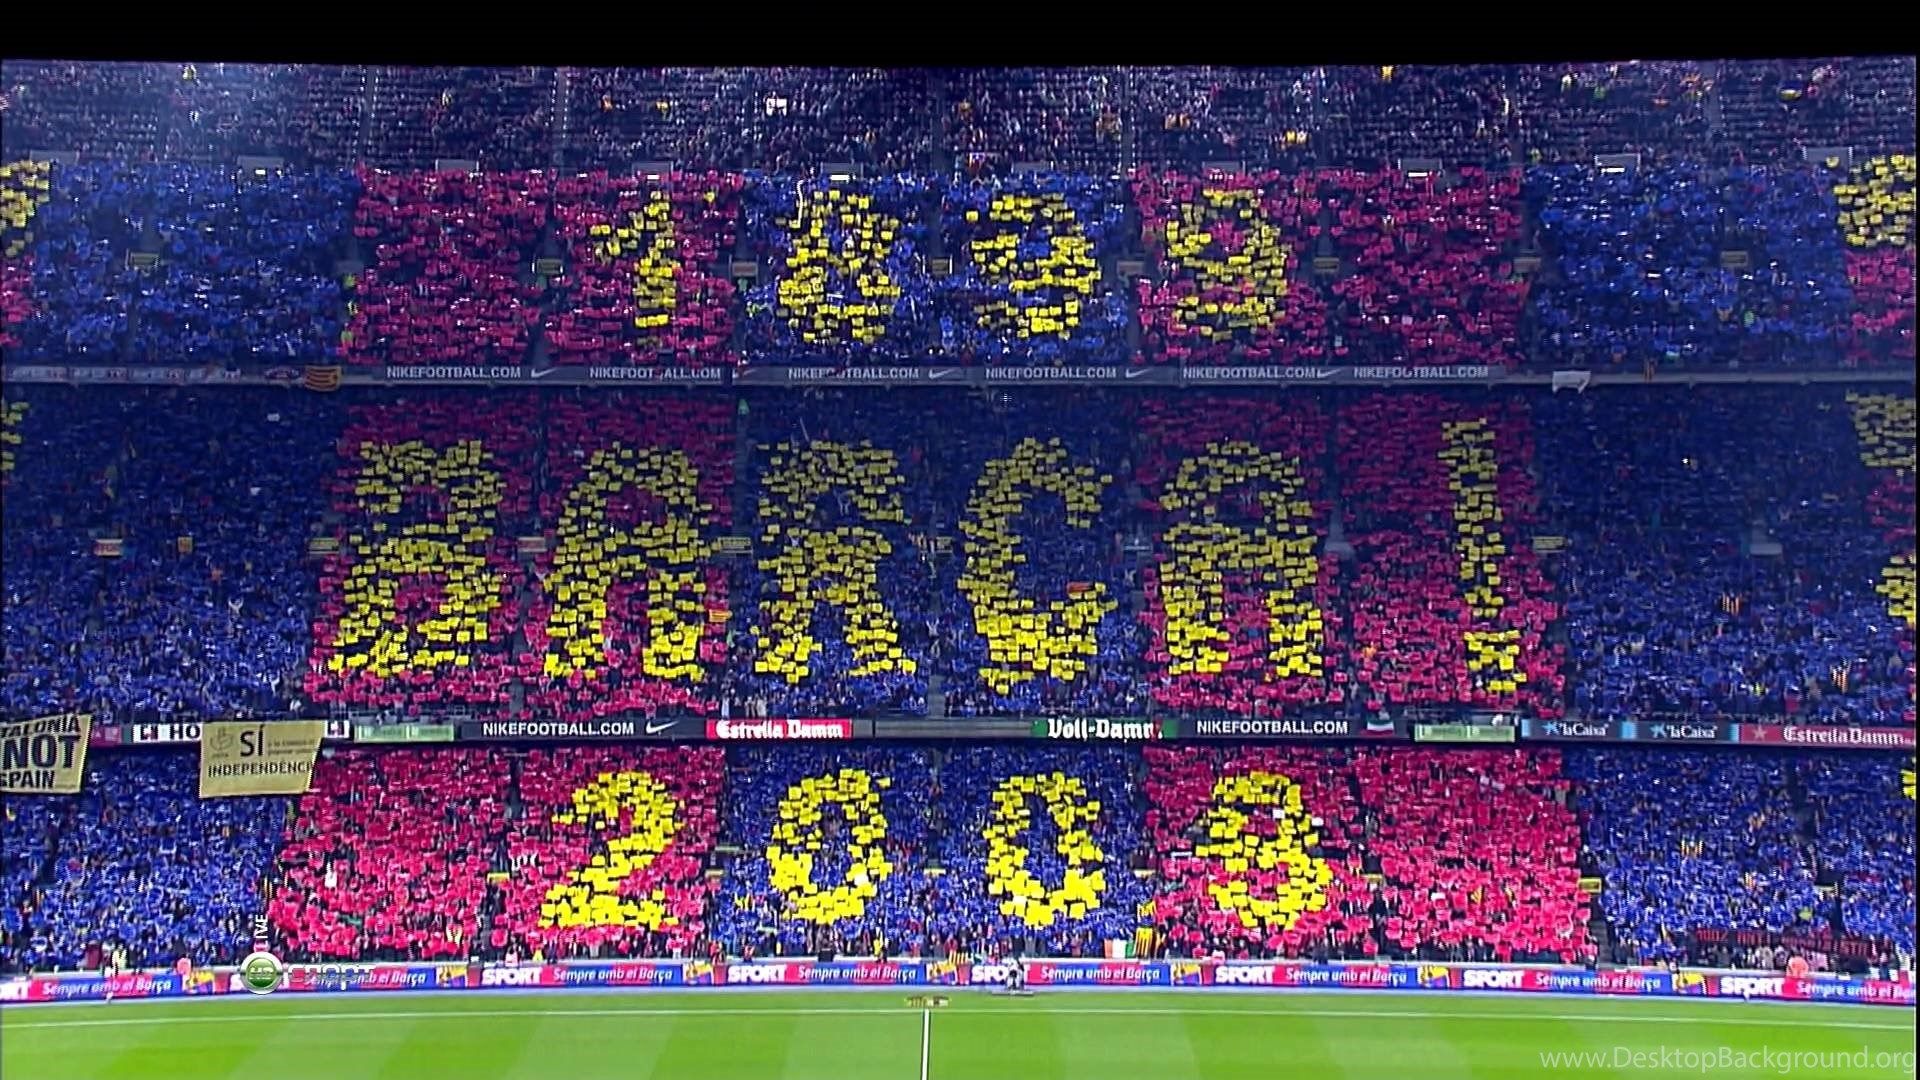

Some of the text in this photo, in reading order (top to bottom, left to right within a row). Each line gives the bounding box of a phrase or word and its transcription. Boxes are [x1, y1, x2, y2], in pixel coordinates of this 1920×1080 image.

[385, 367, 521, 378] NIKEFOOTBALL.COM
[589, 367, 721, 379] NIKEFOOTALL.COM
[985, 368, 1117, 379] NIKEFOOTBALL.COM
[1182, 367, 1316, 379] NIKEFOOTBALL.COM
[483, 722, 634, 736] NIKEFOOTBALL.COM
[716, 719, 844, 739] Estrella Damm
[1197, 721, 1348, 735] NIKEFOOTBALL.COM
[240, 724, 264, 757] SÍ
[2, 735, 81, 769] NOT
[482, 966, 543, 984] SPORT
[553, 968, 595, 983] Sempre
[728, 964, 787, 983] SPORT
[798, 965, 840, 982] Sempre
[1041, 966, 1083, 981] Sempre
[1215, 965, 1276, 984] SPORT
[1463, 969, 1524, 988] SPORT
[1720, 975, 1783, 995] SPORT
